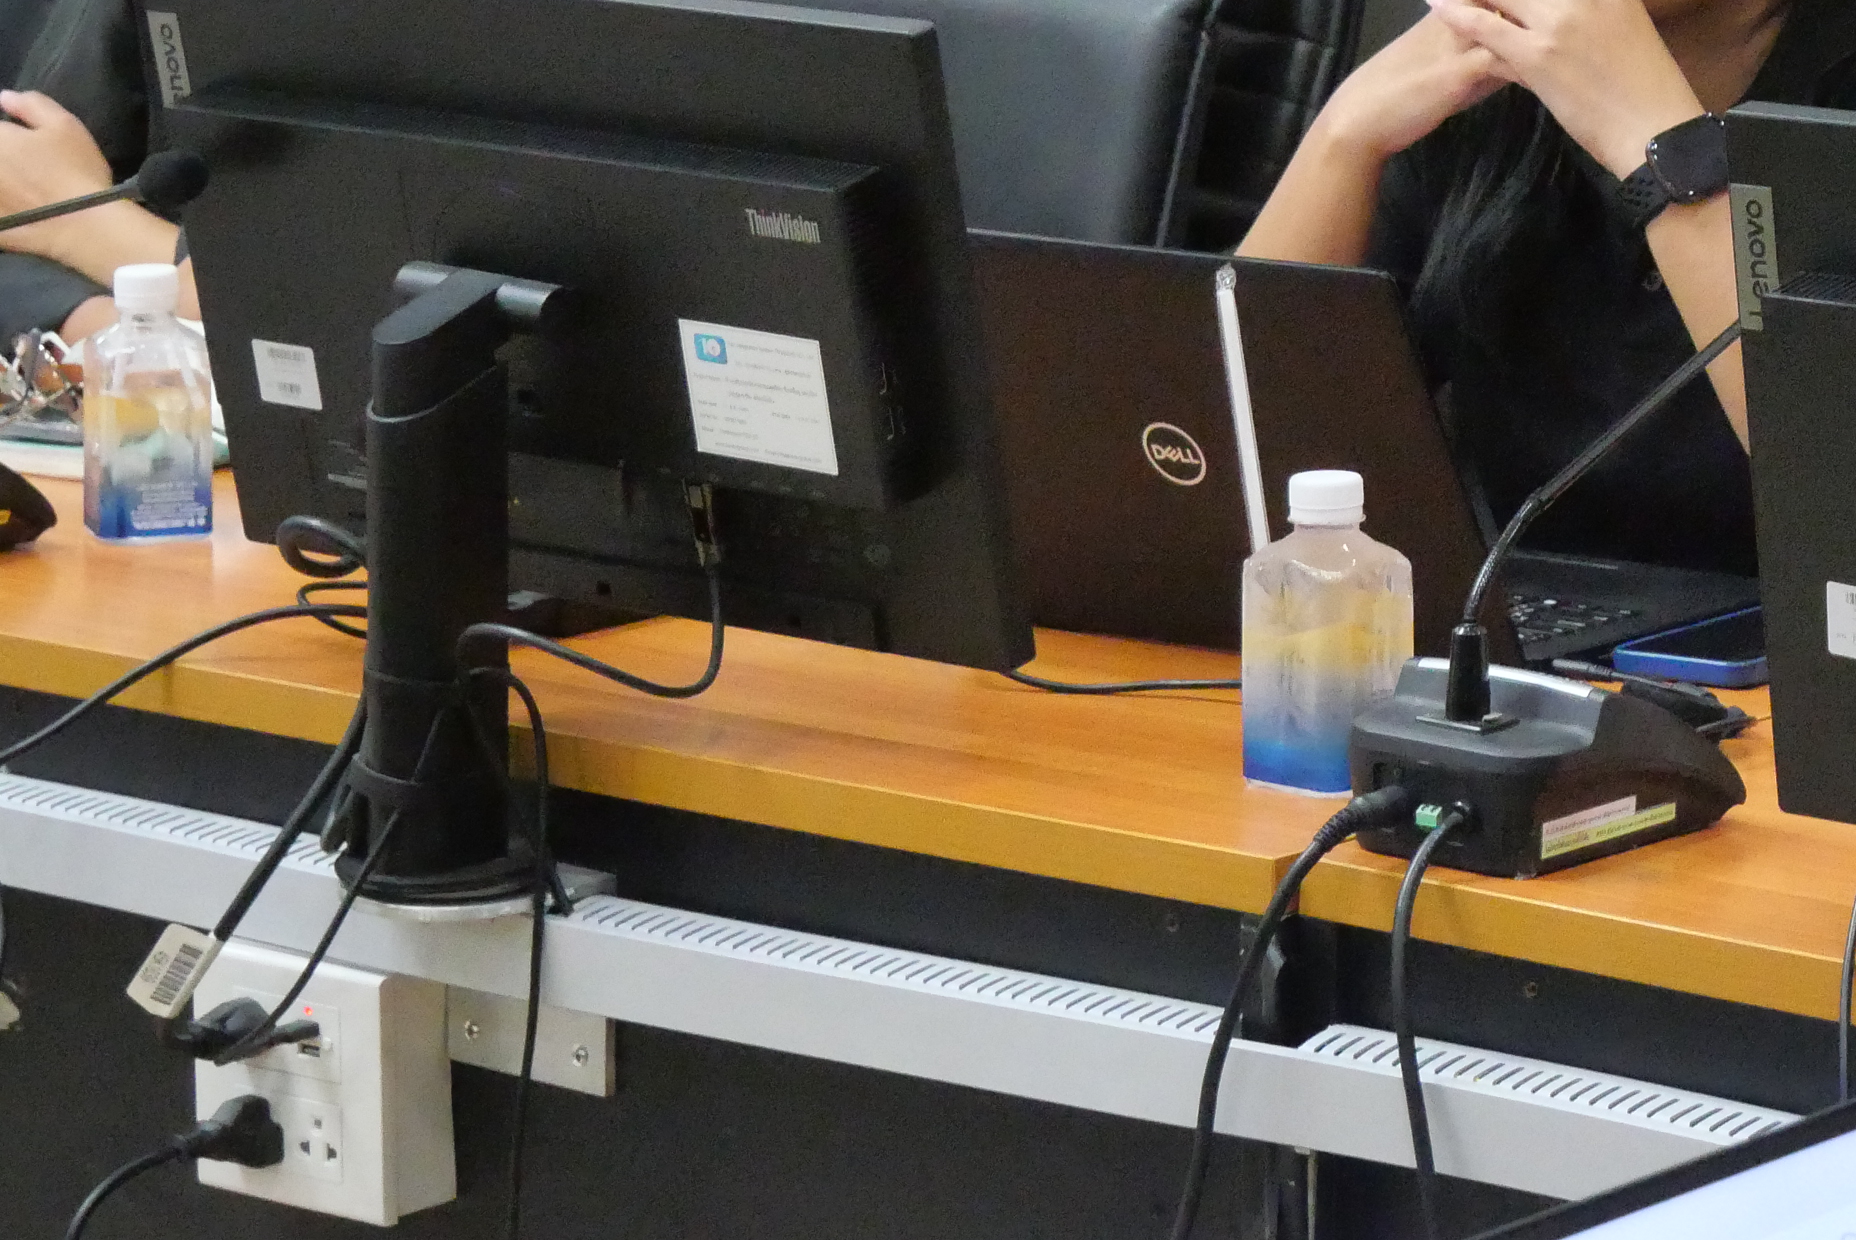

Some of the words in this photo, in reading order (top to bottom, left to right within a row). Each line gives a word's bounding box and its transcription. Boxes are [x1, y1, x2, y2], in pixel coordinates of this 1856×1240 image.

[160, 23, 184, 105] novo
[745, 208, 821, 244] ThinkVision
[1150, 444, 1201, 465] DELL
